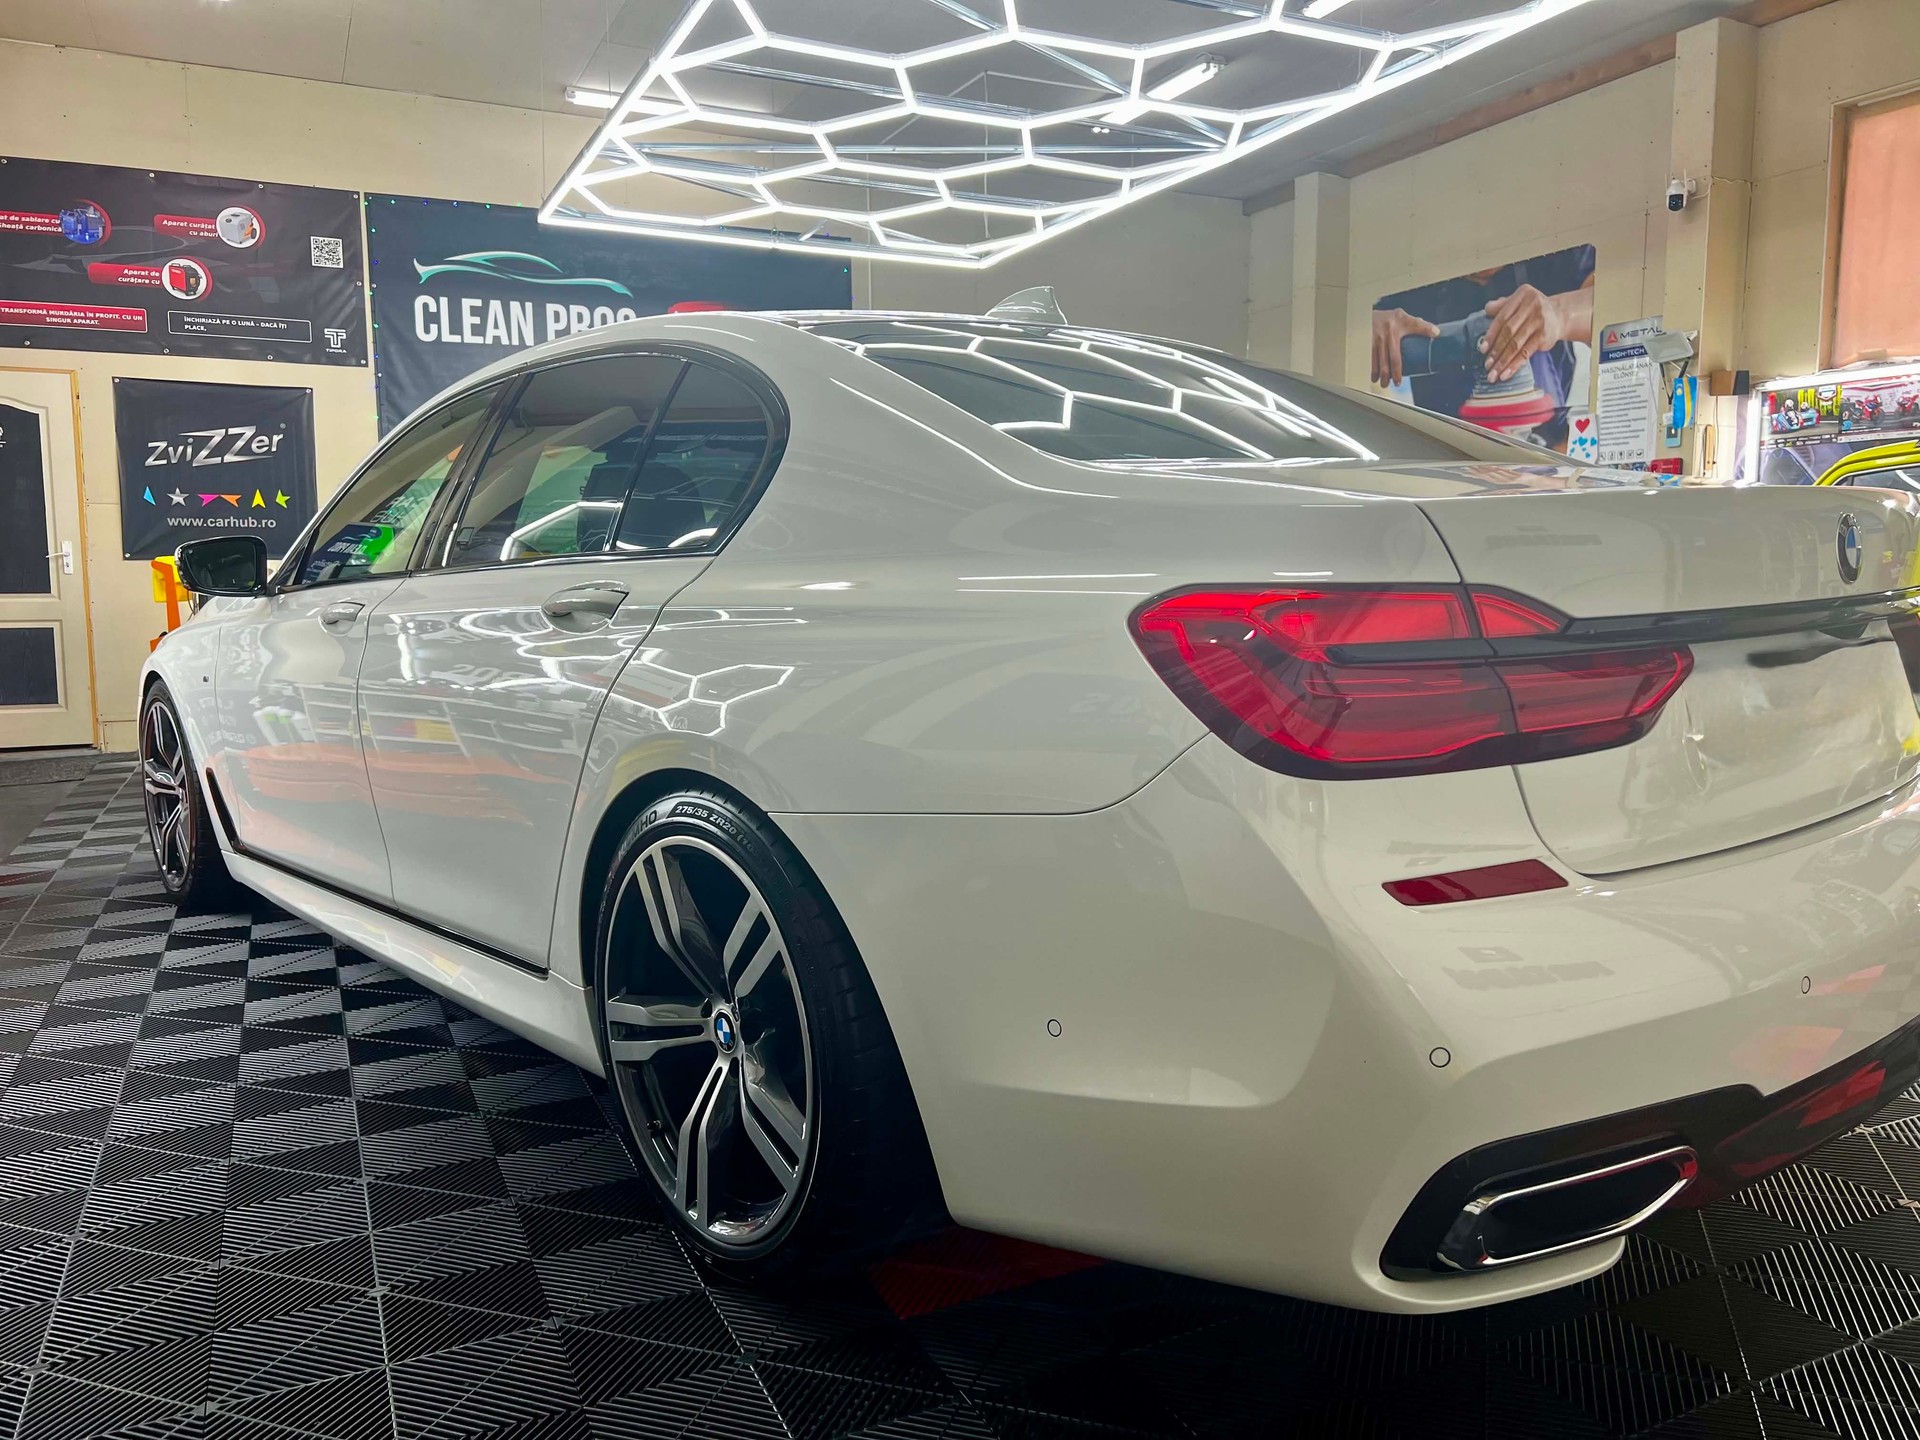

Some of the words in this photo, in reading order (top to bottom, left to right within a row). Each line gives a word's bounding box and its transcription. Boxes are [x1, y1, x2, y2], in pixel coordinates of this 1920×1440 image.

[21, 215, 49, 223] sablare
[162, 219, 187, 228] Aparat
[123, 268, 149, 277] Aparat
[414, 294, 535, 347] CLEAN
[1620, 327, 1663, 339] METAL
[1608, 348, 1645, 359] HIGH-TECH
[167, 516, 277, 529] www.carhub.ro
[675, 805, 709, 818] 275/35
[709, 812, 738, 834] ZR20
